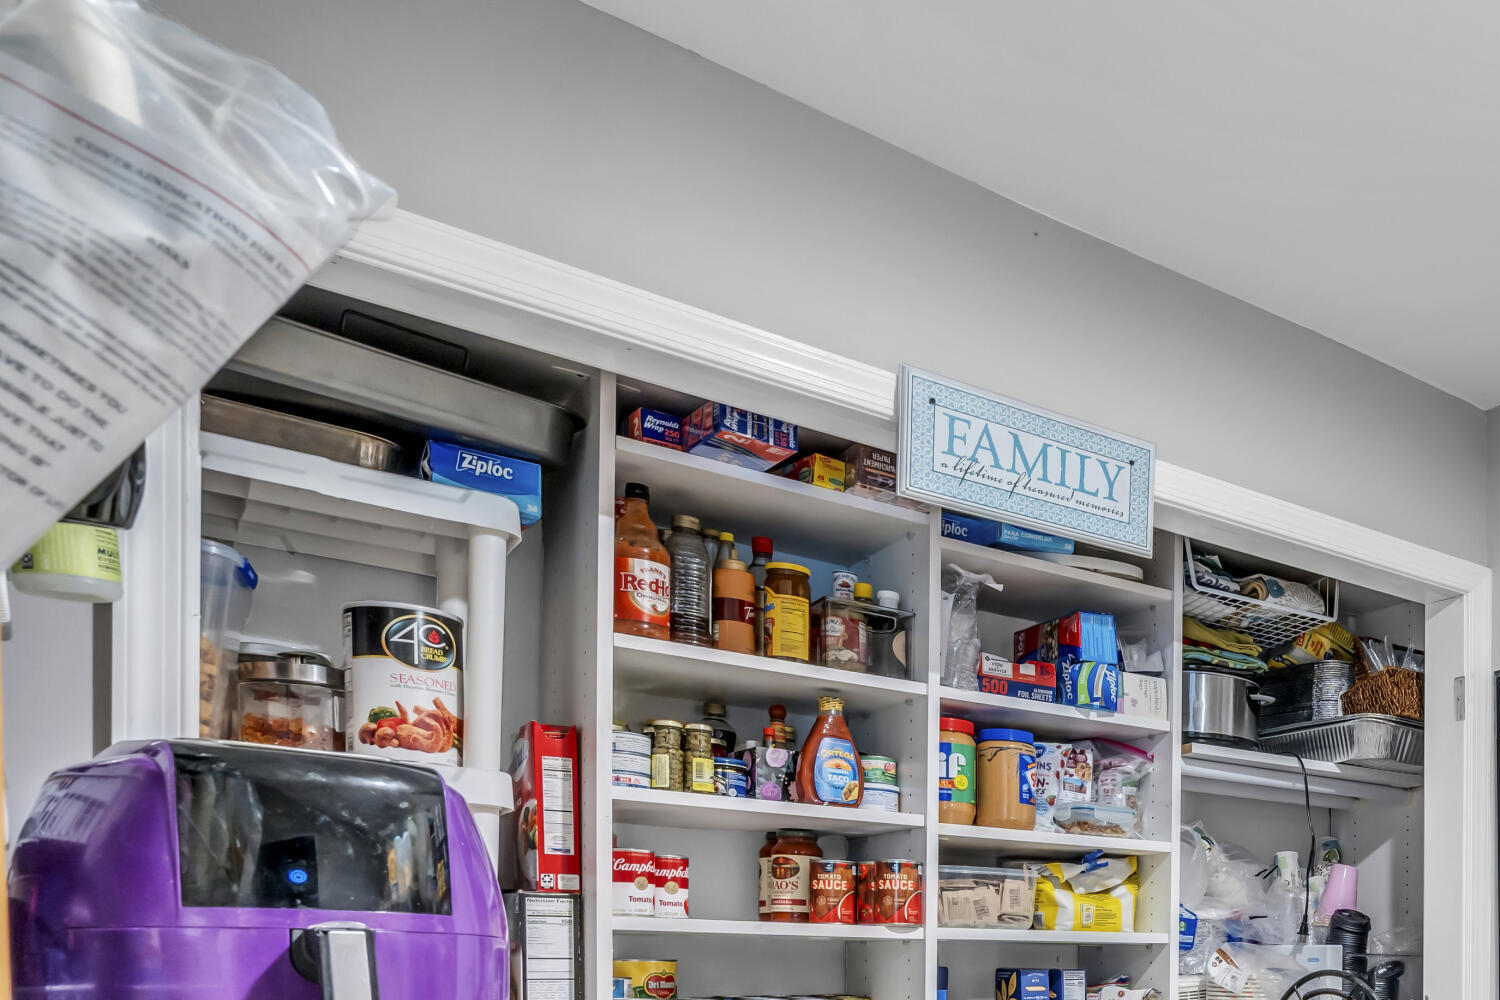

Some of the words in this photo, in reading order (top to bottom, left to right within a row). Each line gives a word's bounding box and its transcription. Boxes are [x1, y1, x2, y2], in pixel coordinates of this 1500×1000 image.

[642, 420, 666, 434] Wrap
[646, 413, 680, 430] Reynolds
[664, 429, 680, 440] 250
[872, 452, 891, 464] PAPER
[941, 411, 1126, 503] FAMILY
[458, 452, 514, 481] Ziploc
[941, 461, 949, 470] a
[952, 455, 1003, 487] lifetime
[1006, 471, 1027, 501] of
[1022, 480, 1075, 504] treasured
[1074, 495, 1125, 518] memories
[389, 620, 447, 666] 4C
[420, 645, 444, 656] BREAD
[388, 672, 457, 693] SEASONED
[1060, 658, 1075, 701] Ziploc
[1105, 669, 1119, 703] Ziploc
[981, 677, 1009, 696] 500
[1017, 689, 1032, 700] FOIL
[1031, 692, 1053, 703] SHEETS
[820, 749, 855, 762] ORTEGA
[827, 773, 850, 784] TACO
[817, 873, 842, 881] TOMATO
[883, 873, 909, 881] TOMATO
[812, 879, 848, 891] SAUCE
[878, 879, 914, 891] SAUCE
[628, 895, 653, 905] Tomato
[658, 899, 684, 909] Tomato
[647, 980, 660, 989] Del
